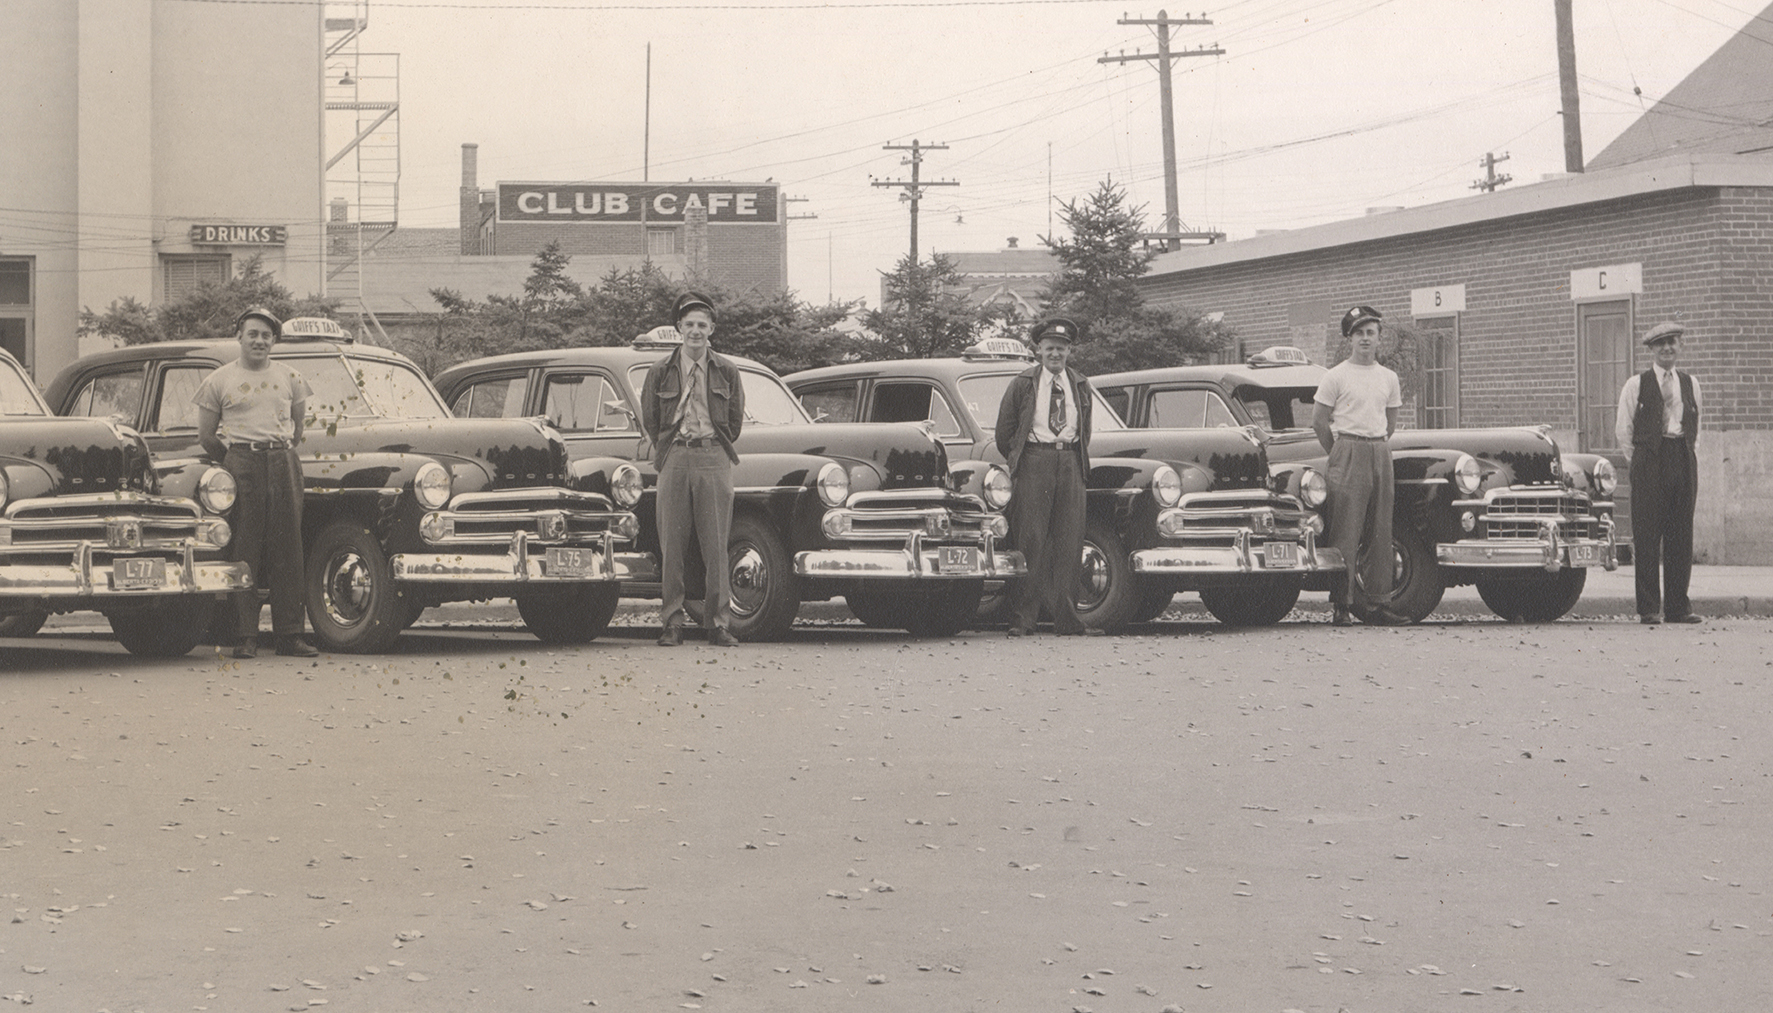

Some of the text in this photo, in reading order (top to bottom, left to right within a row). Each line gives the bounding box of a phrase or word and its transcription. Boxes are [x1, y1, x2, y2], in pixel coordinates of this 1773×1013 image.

[517, 191, 758, 216] CLUB CAFE
[205, 226, 271, 242] DRINKS
[1599, 271, 1607, 290] C
[1435, 291, 1442, 307] B
[291, 320, 320, 334] GRIFF'S
